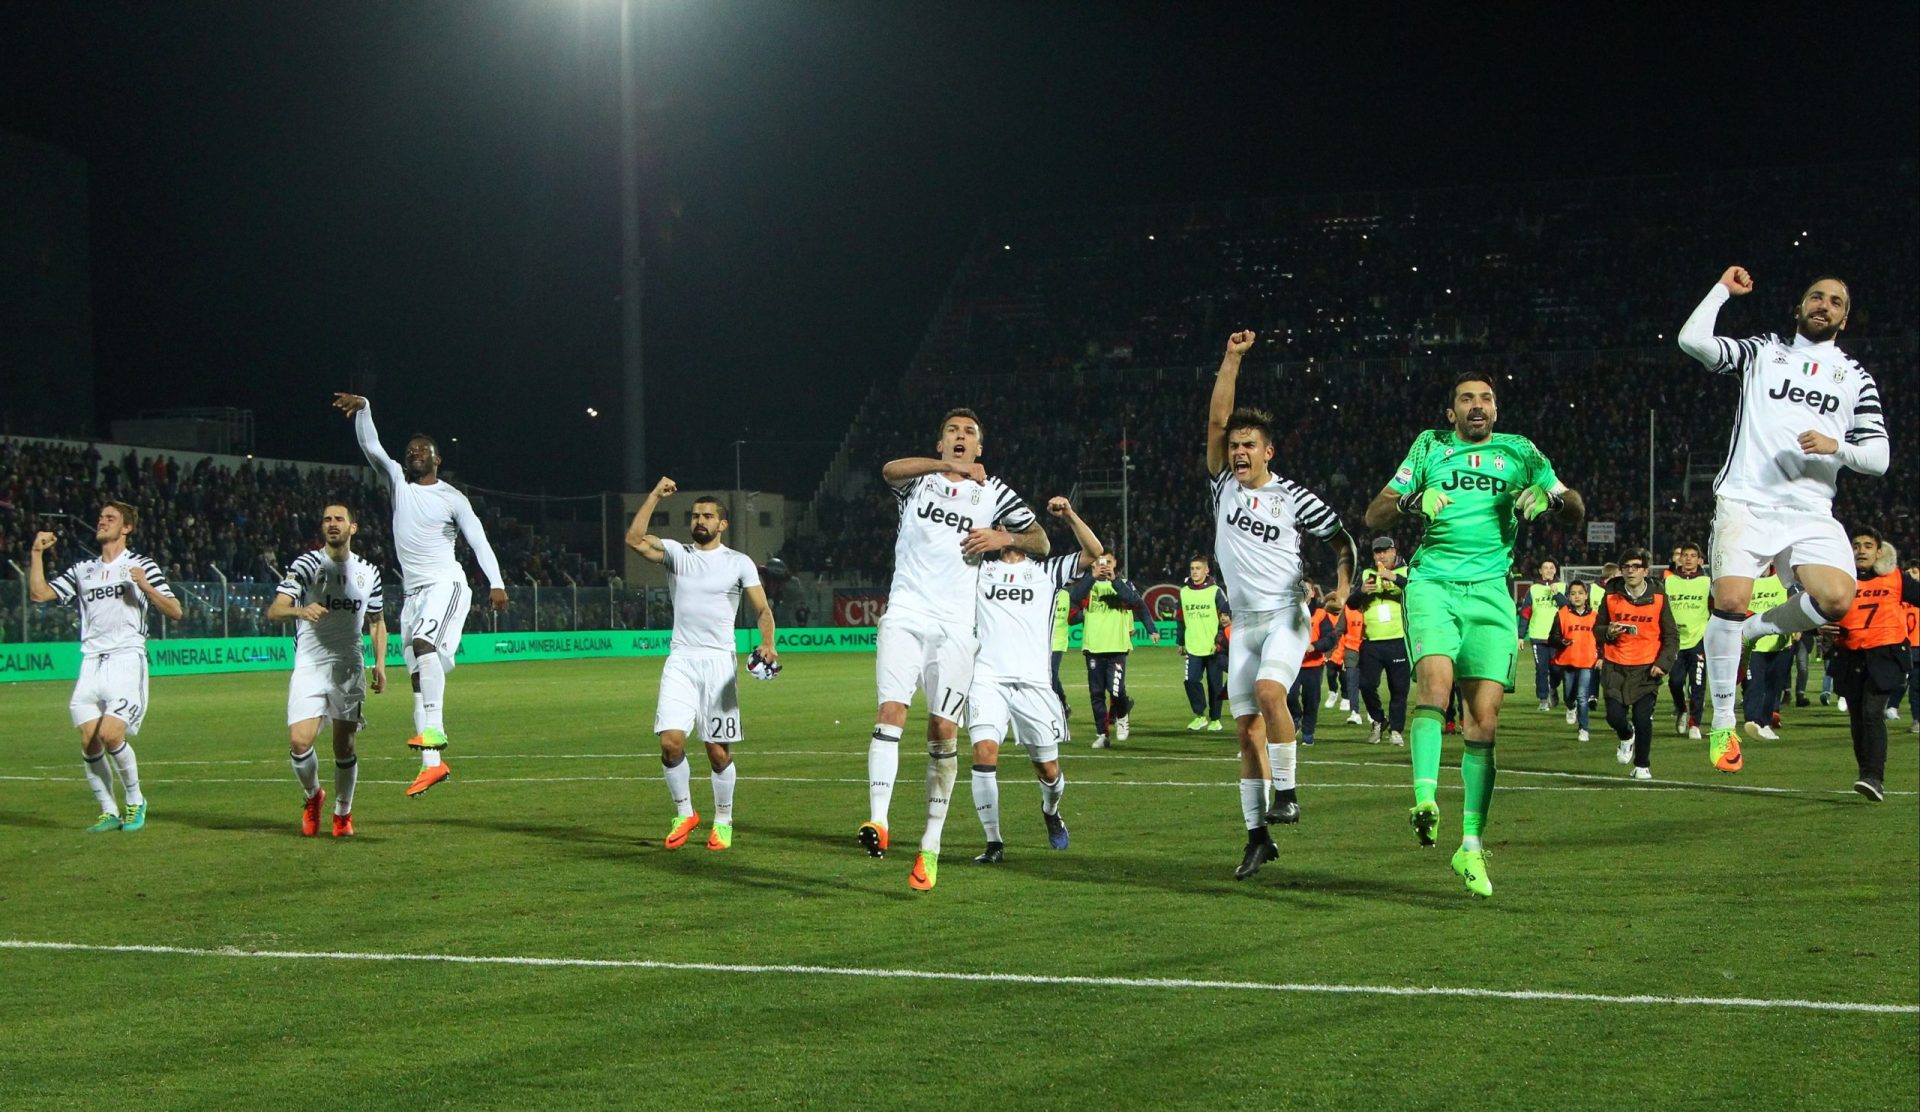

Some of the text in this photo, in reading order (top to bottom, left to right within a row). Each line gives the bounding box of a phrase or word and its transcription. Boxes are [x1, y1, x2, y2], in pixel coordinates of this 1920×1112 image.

[1769, 379, 1839, 415] Jeep
[1442, 470, 1507, 496] Jeep
[917, 502, 974, 534] Jeep
[1227, 507, 1280, 542] Jeep
[87, 583, 126, 602] Jeep
[985, 585, 1034, 604] Jeep
[844, 600, 887, 625] CR
[1858, 603, 1879, 629] 7
[412, 617, 438, 640] 22
[776, 634, 836, 646] ACQUA
[156, 647, 223, 666] MINERALE
[226, 646, 287, 663] ALCALINA
[528, 638, 571, 652] MINERALE
[573, 637, 613, 651] ALCALINA
[113, 698, 139, 726] 24
[941, 687, 965, 715] 17
[712, 717, 736, 739] 28
[1051, 720, 1060, 741] 5
